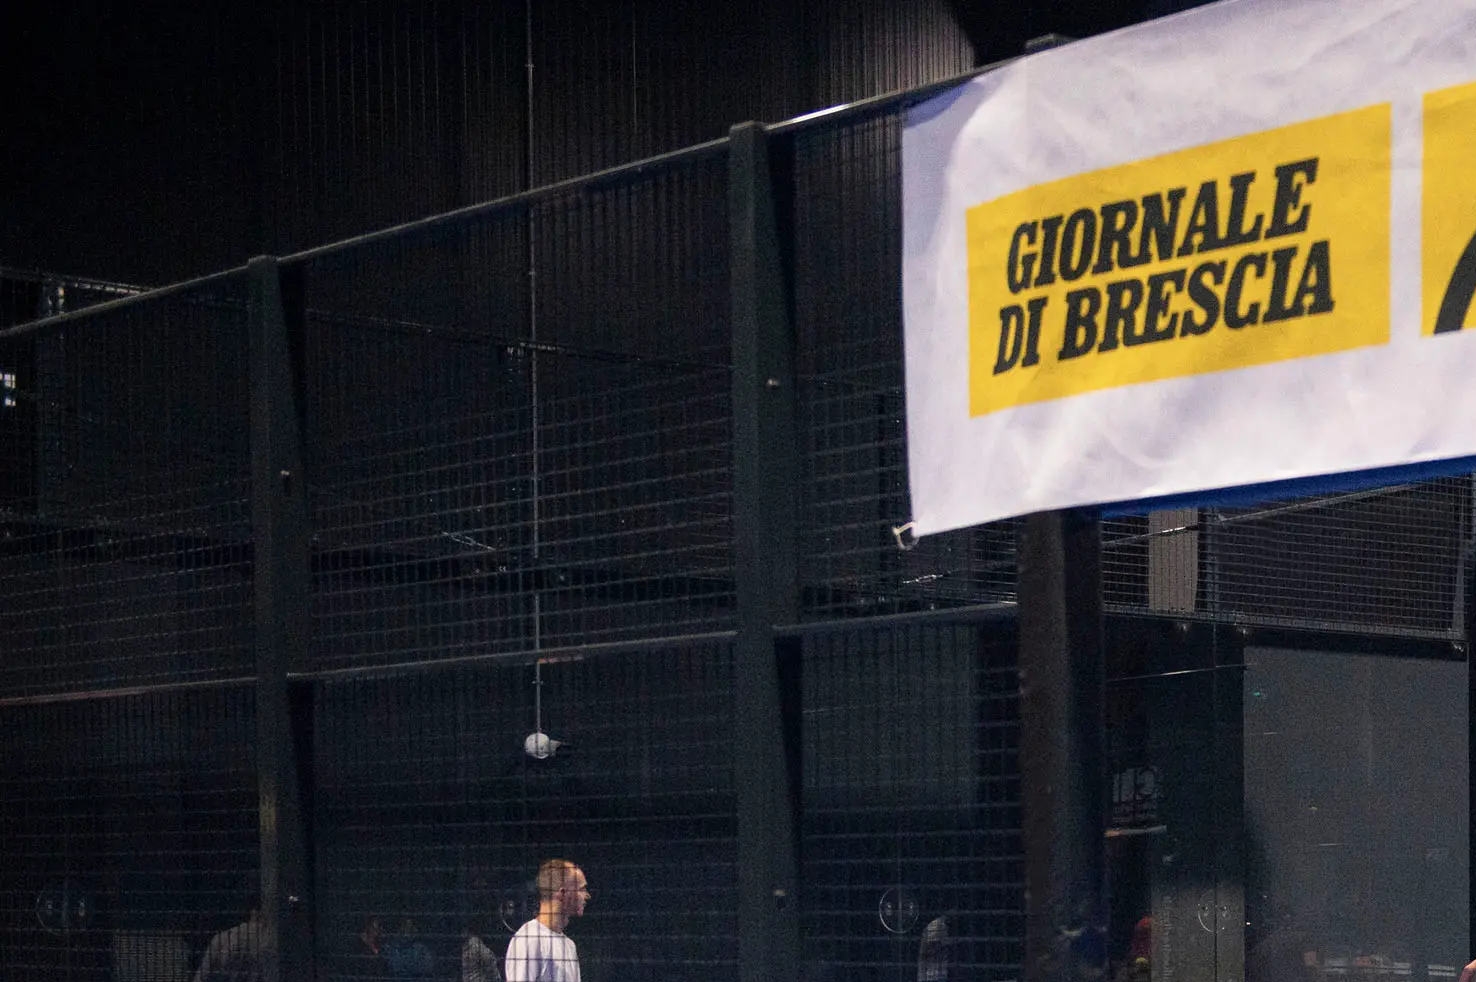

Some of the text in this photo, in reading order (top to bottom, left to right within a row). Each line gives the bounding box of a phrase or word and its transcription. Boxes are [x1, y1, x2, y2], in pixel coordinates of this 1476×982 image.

[1007, 157, 1319, 294] GIORNALE
[993, 240, 1336, 376] DI BRESCIA
